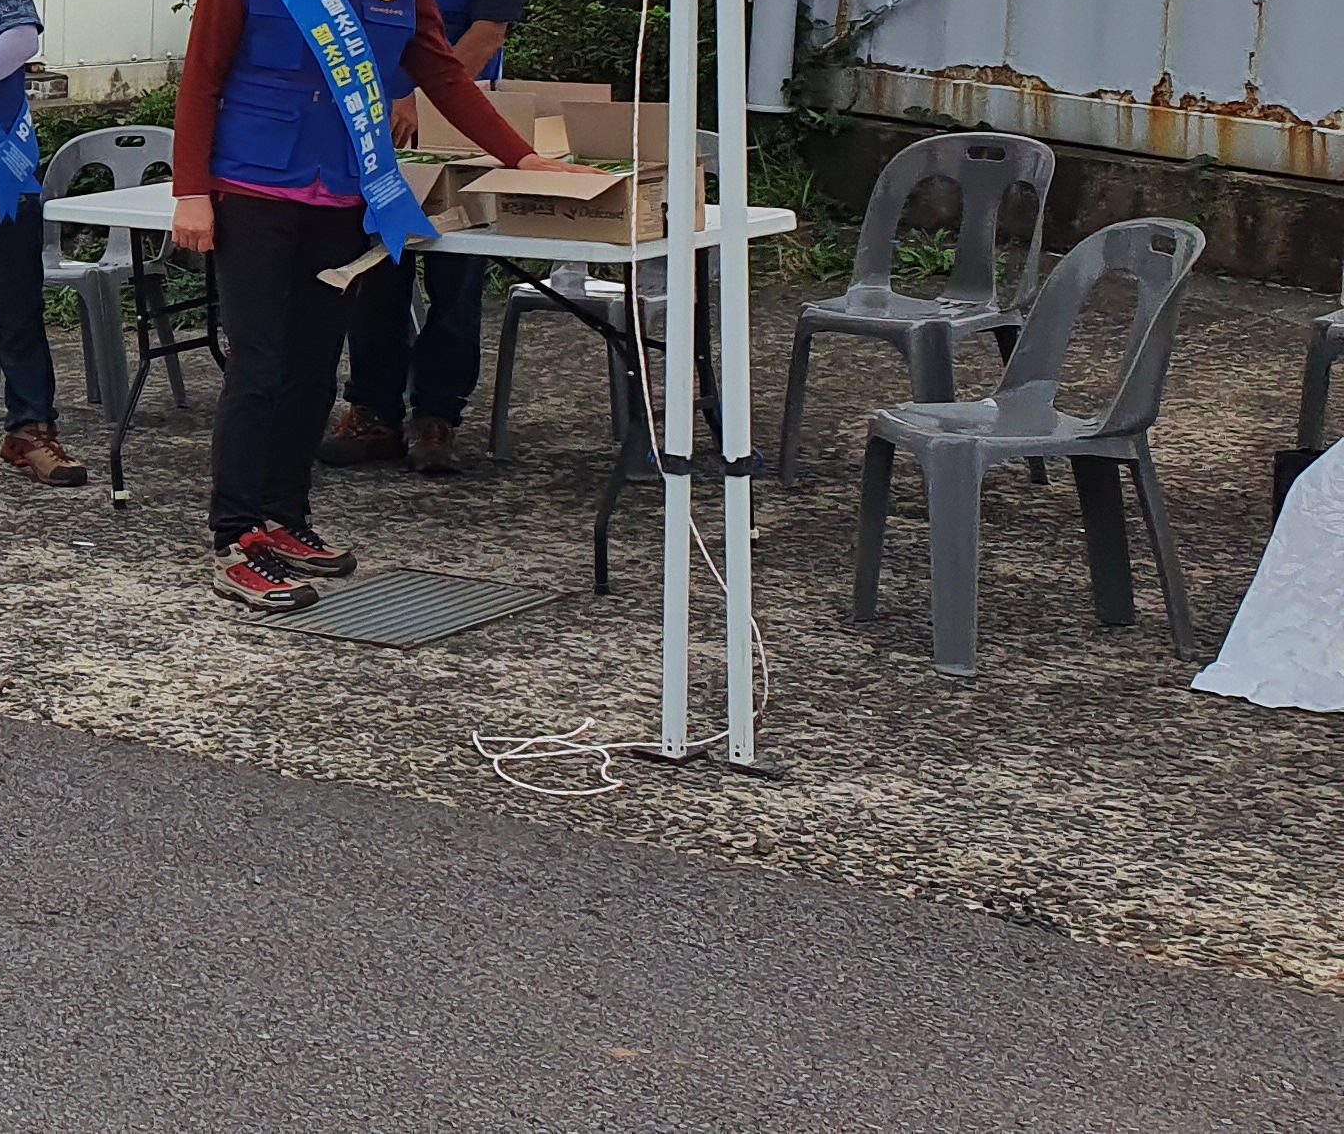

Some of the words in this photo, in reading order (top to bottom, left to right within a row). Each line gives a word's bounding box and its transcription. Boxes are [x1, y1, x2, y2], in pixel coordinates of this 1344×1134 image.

[311, 23, 352, 87] 벌초만
[343, 90, 379, 175] 해주세요
[355, 60, 384, 137] 잠시만,
